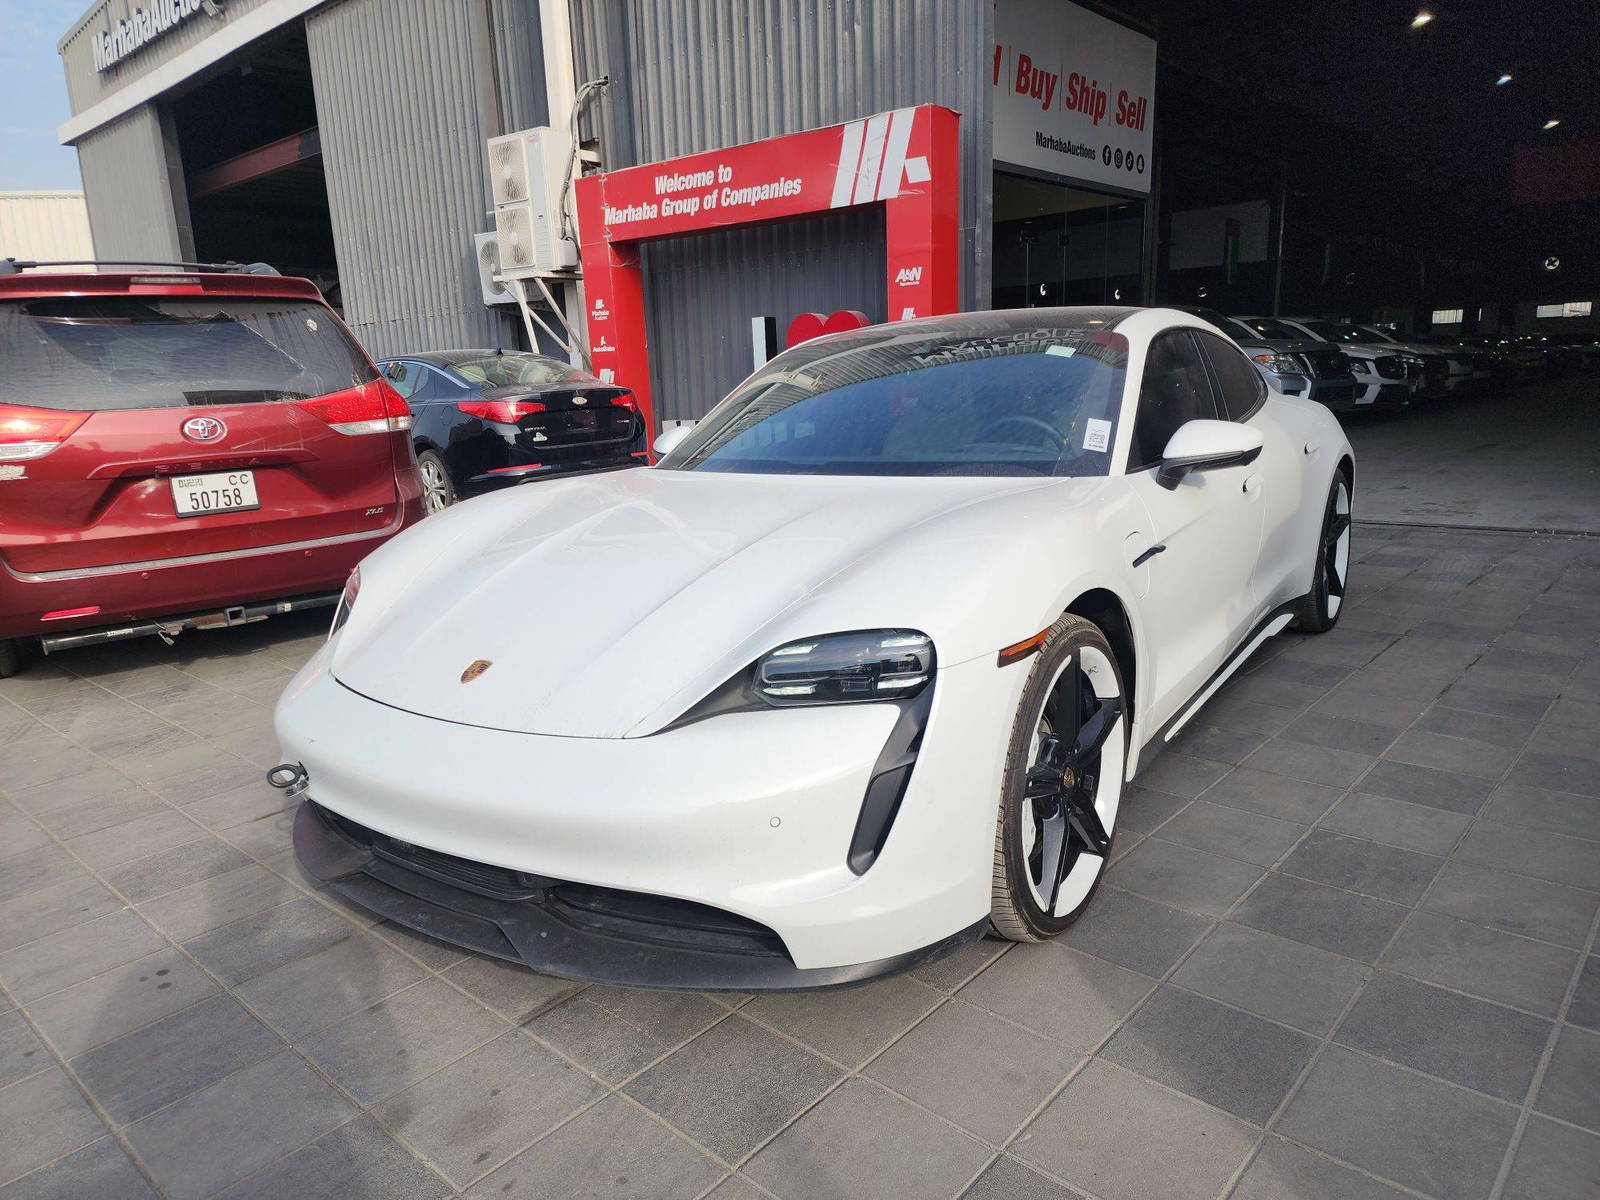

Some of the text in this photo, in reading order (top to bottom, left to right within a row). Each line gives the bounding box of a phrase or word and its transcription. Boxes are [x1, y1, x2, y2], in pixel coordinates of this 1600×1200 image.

[1015, 53, 1058, 111] Buy
[1066, 72, 1107, 126] Ship
[1116, 89, 1148, 132] Sell
[1035, 131, 1097, 161] MarhabaAuctions
[655, 164, 732, 195] Welcome to
[604, 176, 803, 225] Marhaba Group of Companies
[190, 488, 243, 511] 50758
